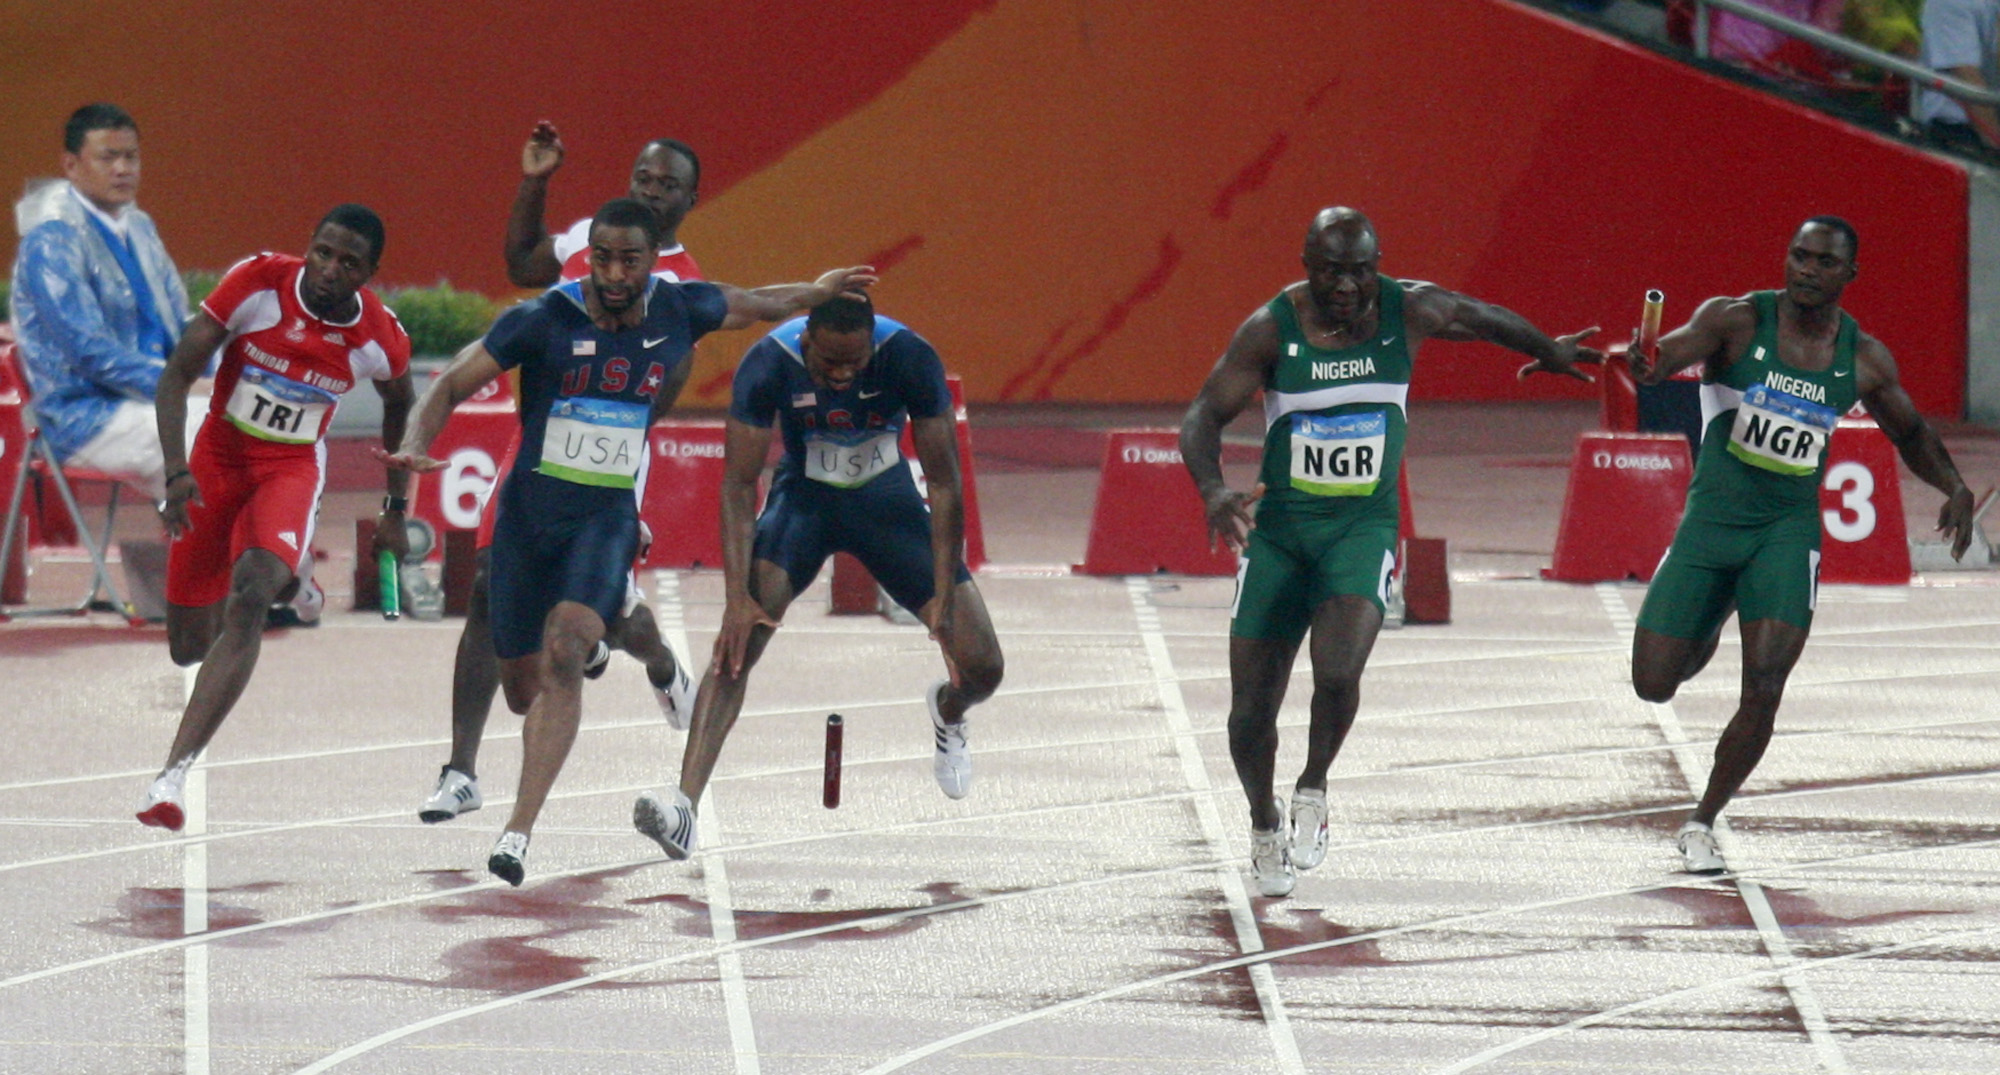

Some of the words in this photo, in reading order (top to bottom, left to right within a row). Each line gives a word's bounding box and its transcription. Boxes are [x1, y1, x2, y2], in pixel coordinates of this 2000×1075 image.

[244, 341, 290, 374] TRINIDAD
[1311, 357, 1377, 380] NIGERIA
[560, 357, 666, 397] USA
[1764, 370, 1826, 404] NIGERIA
[251, 393, 305, 433] TRI
[565, 431, 630, 466] USA
[681, 442, 725, 458] OMEG
[1743, 414, 1814, 459] NGR
[820, 445, 885, 478] USA
[1144, 449, 1184, 464] OME
[1304, 444, 1374, 477] NGR
[1614, 454, 1673, 470] OMEGA
[441, 448, 497, 529] 6
[1823, 461, 1877, 542] 3
